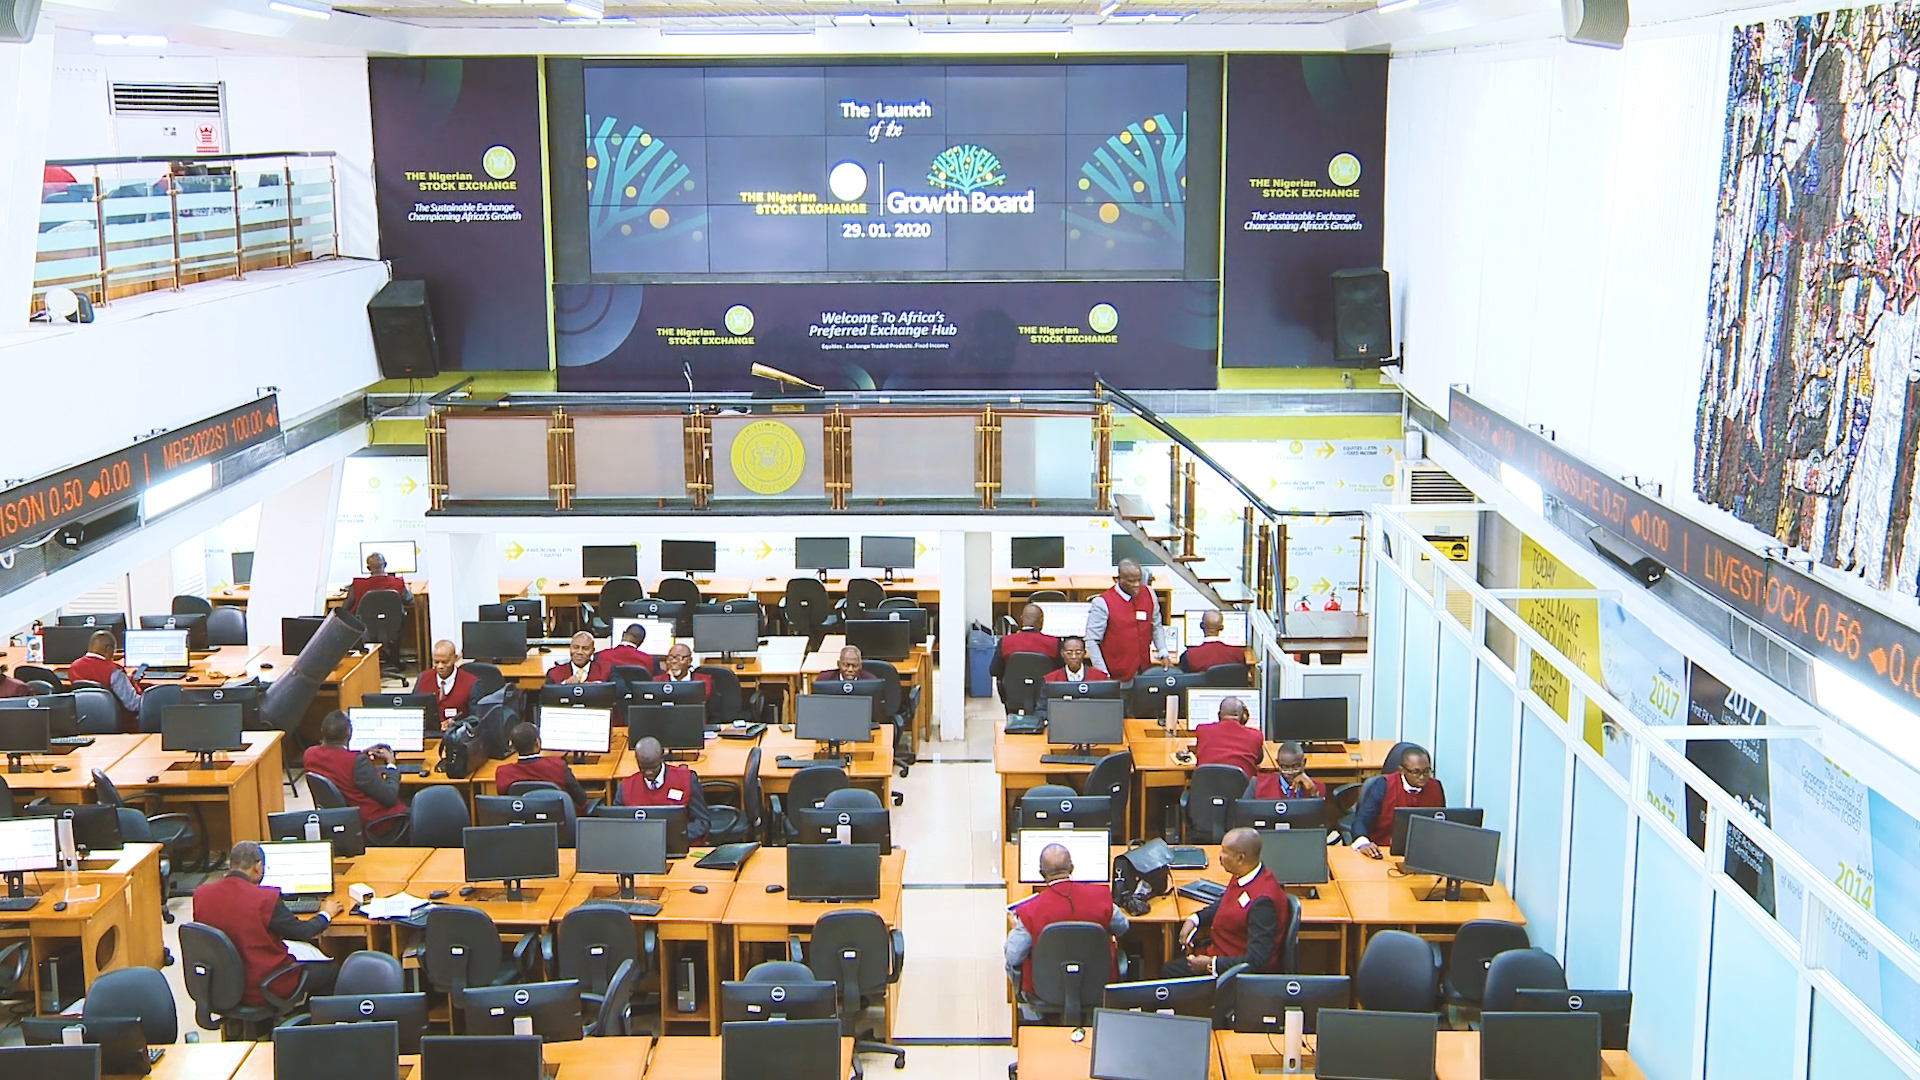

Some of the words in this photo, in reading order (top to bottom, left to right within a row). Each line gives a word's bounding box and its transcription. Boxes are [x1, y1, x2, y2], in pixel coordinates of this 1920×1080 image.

[840, 102, 870, 117] The
[877, 101, 932, 117] Launch
[868, 121, 885, 142] of
[885, 121, 904, 137] the
[404, 172, 426, 180] THE
[429, 172, 473, 182] Nigerian
[1249, 179, 1270, 187] THE
[1273, 179, 1317, 188] Nigerian
[419, 182, 456, 190] STOCK
[458, 181, 517, 190] EXCHANGE
[739, 192, 765, 202] THE
[767, 192, 817, 204] Nigerian
[1262, 189, 1299, 197] STOCK
[1302, 189, 1360, 198] EXCHANGE
[415, 203, 430, 212] The
[430, 203, 476, 212] Sustainable
[476, 203, 515, 213] Exchange
[755, 204, 797, 214] STOCK
[800, 203, 867, 214] EXCHANGE
[887, 190, 968, 214] Growth
[972, 189, 1034, 214] Board
[408, 212, 461, 222] Championing
[461, 212, 490, 222] Africa's
[491, 211, 522, 220] Growth
[1251, 211, 1267, 220] The
[1268, 211, 1315, 220] Sustainable
[1316, 211, 1356, 222] Exchange
[842, 223, 865, 237] 29.
[868, 223, 891, 237] 01.
[894, 223, 931, 237] 2020
[1244, 221, 1299, 232] Championing
[1300, 221, 1330, 232] Africa's
[1330, 221, 1362, 230] Growth
[821, 312, 878, 324] Welcome
[881, 312, 895, 323] To
[898, 311, 945, 325] Africa's
[656, 328, 674, 336] THE
[676, 328, 716, 337] Nigerian
[809, 324, 867, 339] Preferred
[870, 324, 929, 338] Exchange
[931, 324, 958, 336] Hub
[1018, 326, 1037, 334] THE
[1039, 326, 1079, 335] Nigerian
[668, 337, 700, 345] STOCK
[702, 337, 755, 345] EXCHANGE
[1030, 335, 1064, 343] STOCK
[1065, 335, 1118, 343] EXCHANGE
[162, 422, 229, 471] MRE2022S1
[231, 409, 264, 439] 100.00
[50, 478, 83, 518] 0.50
[99, 460, 131, 496] 0.00
[1602, 487, 1627, 526] 0.57
[1641, 509, 1669, 552] 0.00
[1532, 548, 1557, 585] TODAY
[1531, 577, 1555, 617] YOULL
[1555, 598, 1581, 637] MAKE
[1705, 544, 1810, 634] LIVESTOCK
[1815, 603, 1863, 661] 0.56
[1649, 675, 1680, 719] 2017
[1824, 766, 1834, 784] The
[1835, 861, 1873, 909] 2014
